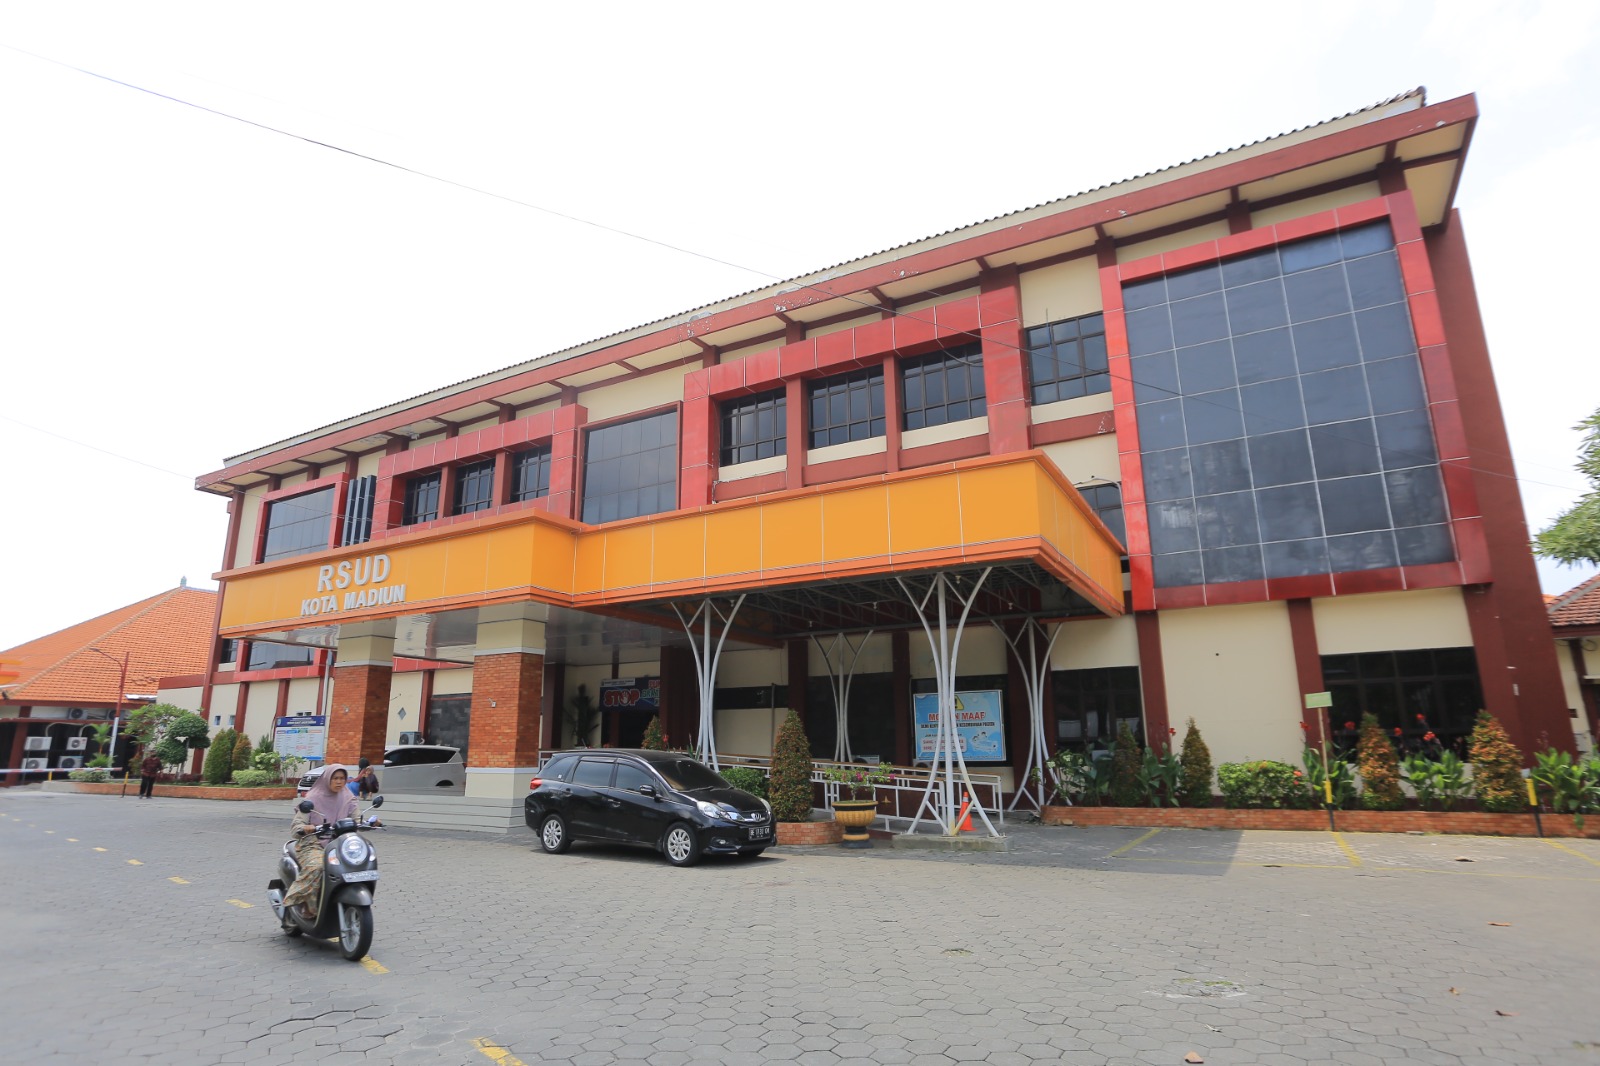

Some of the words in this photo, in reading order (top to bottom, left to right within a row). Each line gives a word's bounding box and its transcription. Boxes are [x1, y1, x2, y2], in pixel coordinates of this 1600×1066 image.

[317, 554, 391, 592] RSUD
[301, 594, 339, 616] KOTA
[344, 584, 406, 610] MADIUN
[604, 689, 640, 707] STOP
[961, 711, 986, 720] MAAF
